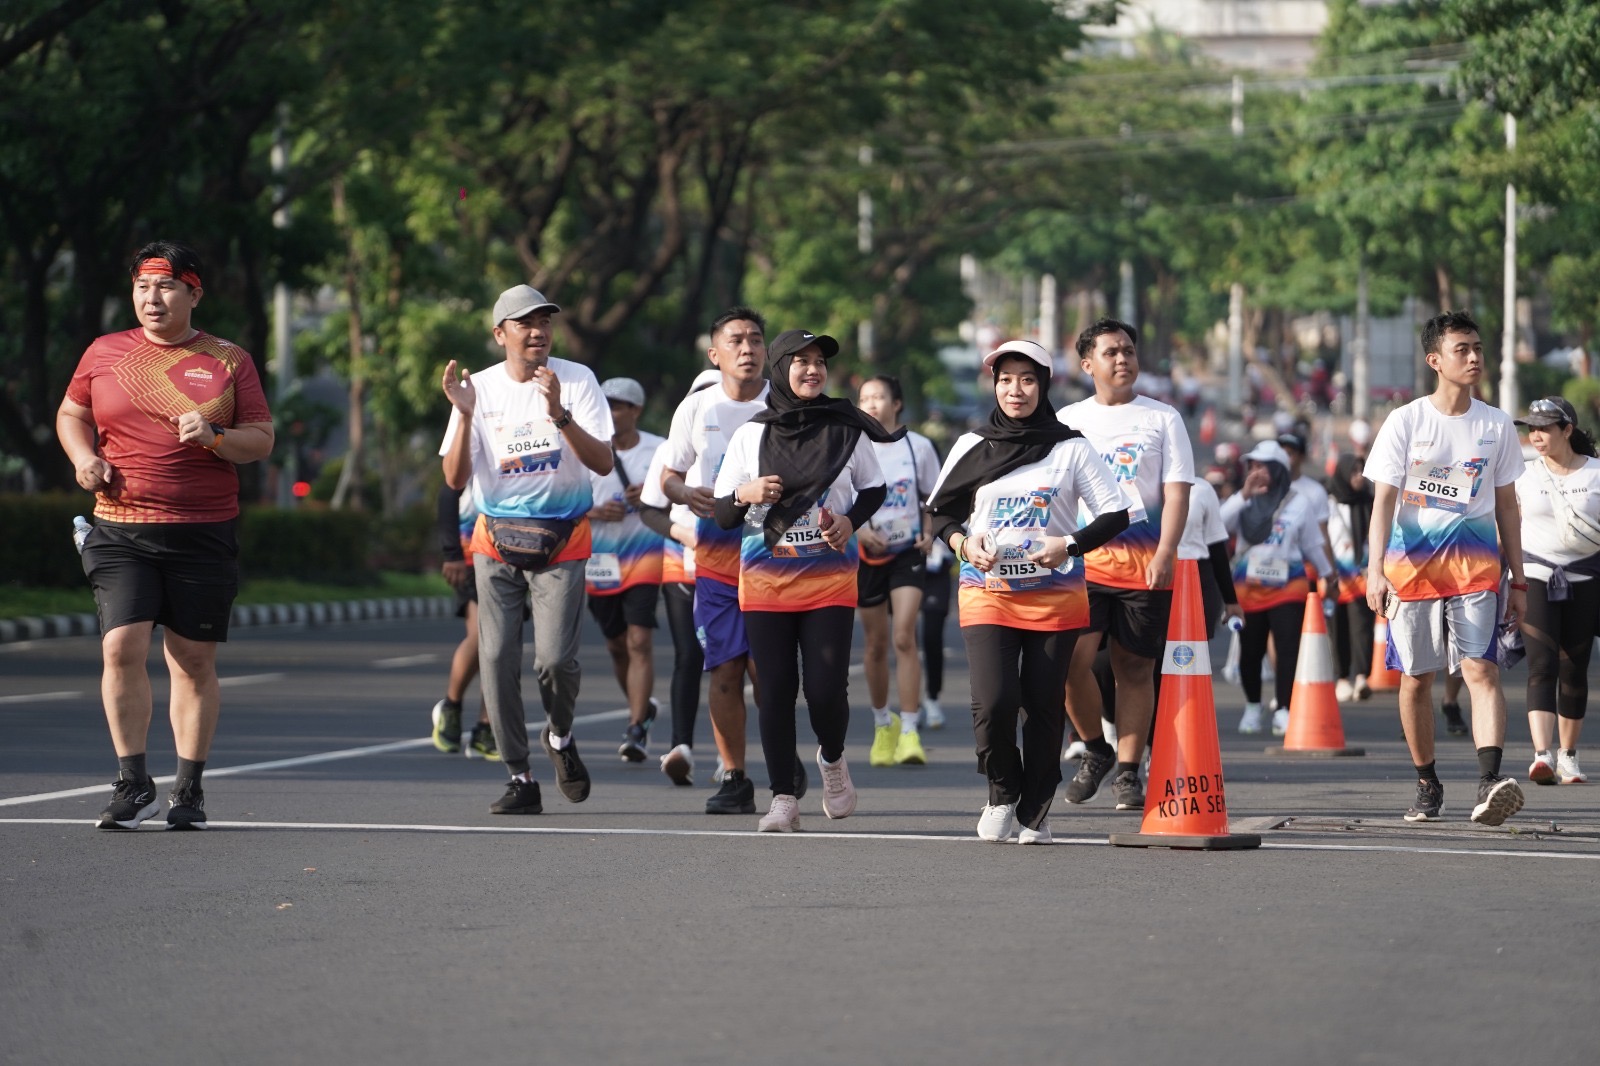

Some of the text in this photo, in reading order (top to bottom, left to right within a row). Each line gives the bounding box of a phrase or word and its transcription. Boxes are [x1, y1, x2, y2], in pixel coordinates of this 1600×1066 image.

[507, 438, 551, 454] 50844
[1418, 480, 1459, 498] 50163
[1572, 486, 1588, 494] BIG
[996, 496, 1032, 510] FUN
[1406, 493, 1421, 503] 5K
[990, 507, 1051, 528] RUN
[785, 528, 822, 543] 51154
[776, 547, 792, 556] 5K
[999, 562, 1037, 576] 51153
[990, 580, 1003, 589] 5K
[1165, 775, 1209, 797] APBD
[1158, 797, 1201, 818] KOTA
